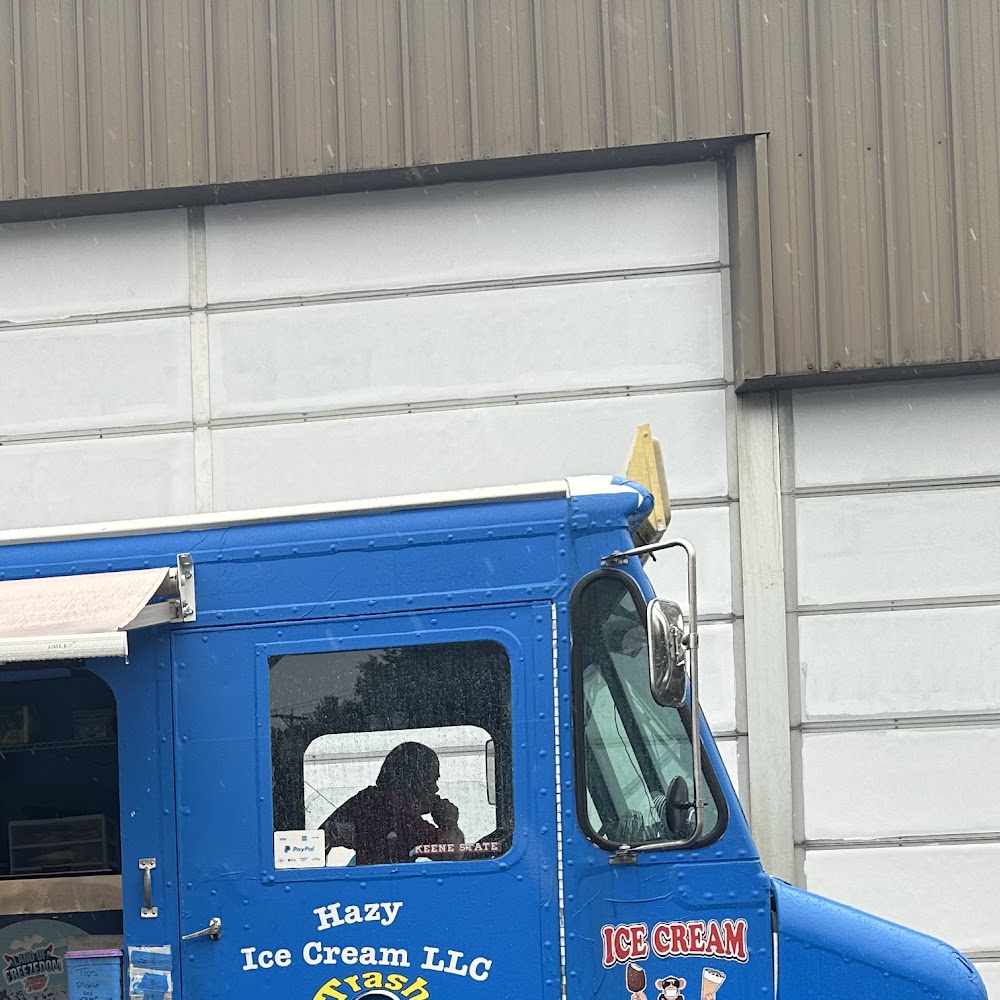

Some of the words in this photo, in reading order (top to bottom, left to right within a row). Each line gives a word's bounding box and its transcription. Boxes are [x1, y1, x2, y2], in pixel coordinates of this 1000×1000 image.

[415, 843, 455, 854] KEENE
[459, 841, 499, 852] STATE
[313, 900, 404, 931] Hazy
[601, 922, 649, 968] ICE
[652, 917, 749, 963] CREAM
[4, 957, 63, 983] FREEZEDOM
[12, 950, 36, 967] LAND
[36, 948, 50, 962] OF
[240, 946, 292, 972] Ice
[302, 941, 410, 969] Cream
[421, 946, 493, 982] LLC
